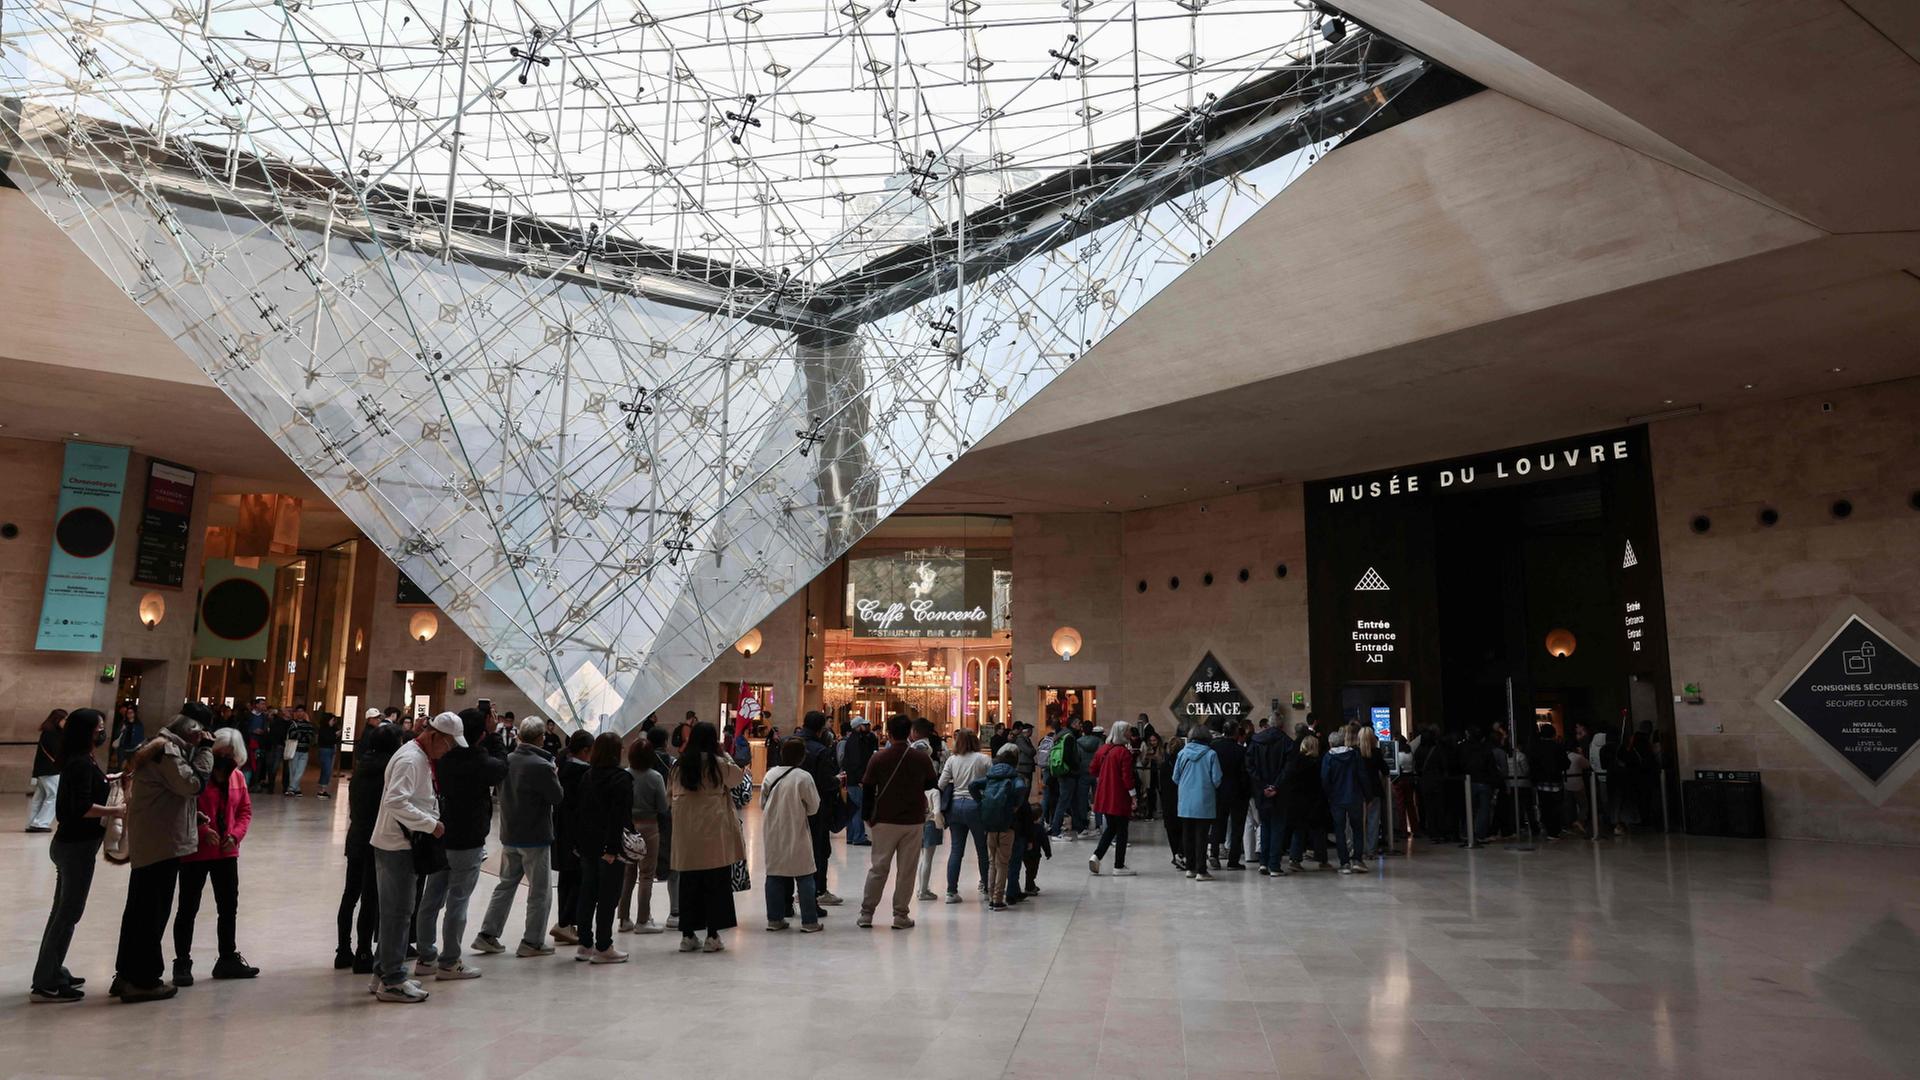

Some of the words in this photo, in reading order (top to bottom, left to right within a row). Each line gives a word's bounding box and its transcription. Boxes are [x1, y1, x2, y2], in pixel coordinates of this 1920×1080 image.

[1329, 475, 1419, 504] MUSÉE
[1440, 467, 1475, 487] DU
[1497, 441, 1629, 478] LOUVRE
[1626, 601, 1641, 612] Entrée
[856, 598, 906, 629] Caffé
[909, 599, 987, 623] Concerto
[1357, 619, 1391, 629] Entrée
[1625, 615, 1644, 626] Entrance
[1352, 631, 1396, 640] Entrance
[1355, 642, 1394, 652] Entrada
[1366, 653, 1383, 663] 入口
[1195, 681, 1230, 693] 货币兑换
[1810, 684, 1862, 692] CONSIGNES
[1825, 699, 1866, 708] SECURED
[1867, 698, 1908, 707] LOCKERS
[1186, 702, 1241, 716] CHANGE
